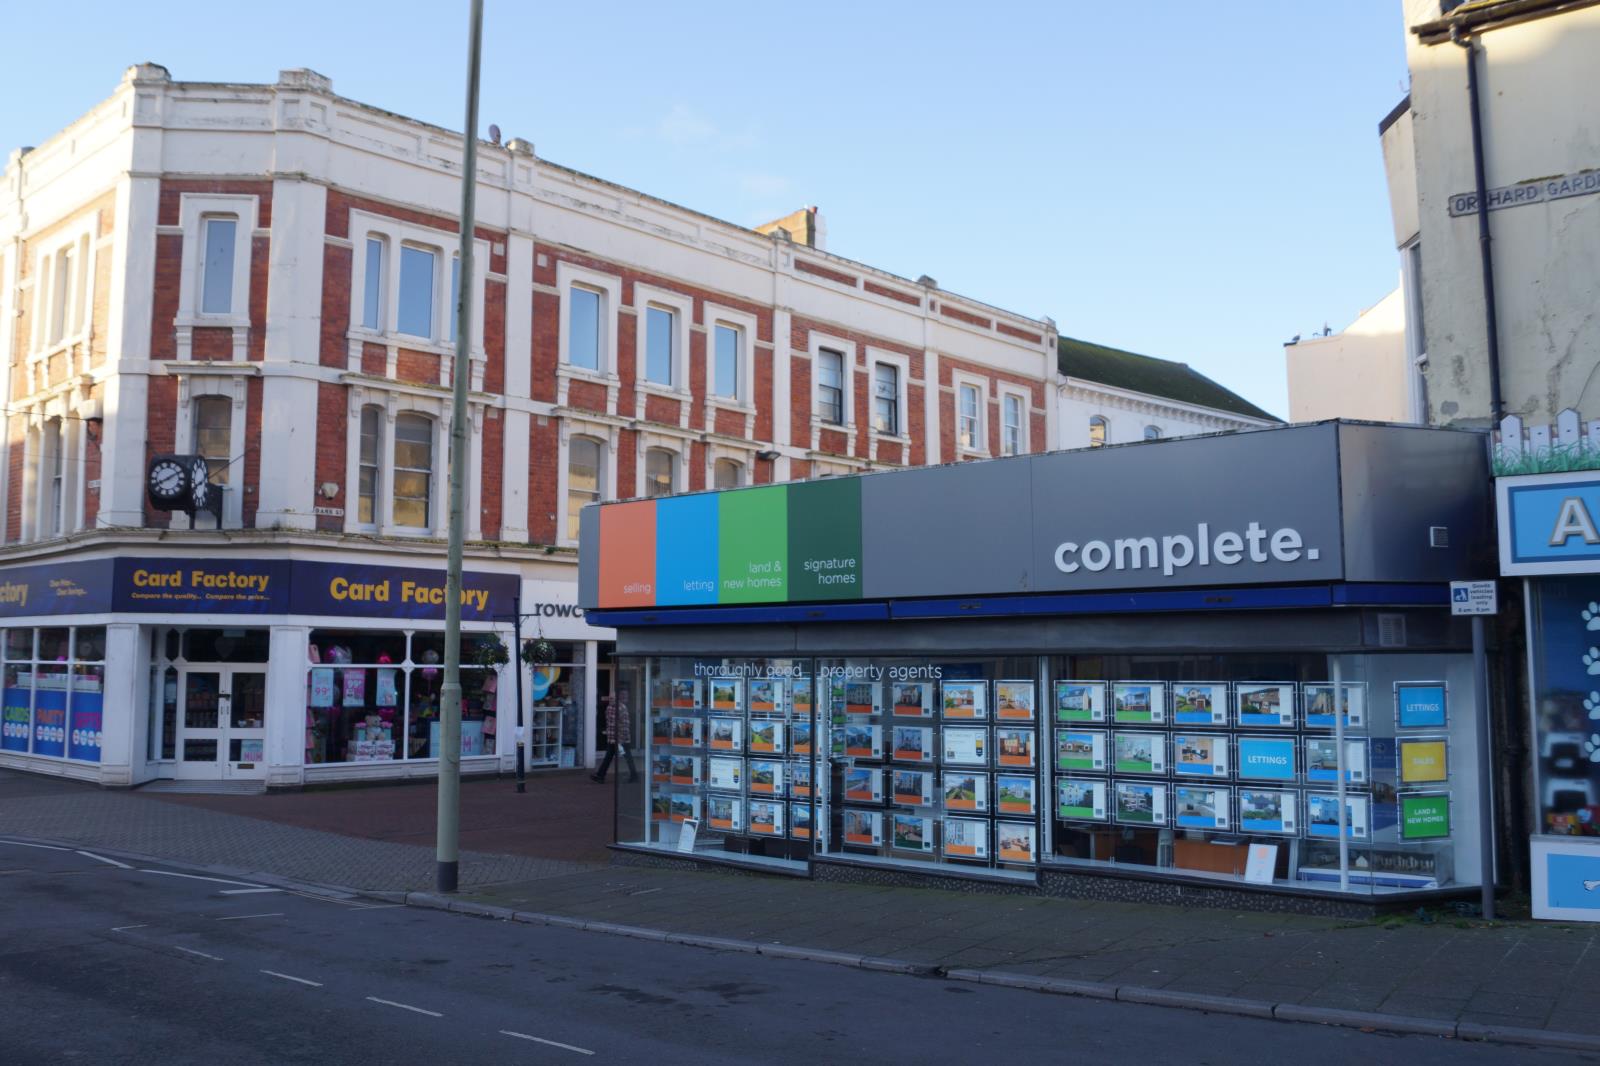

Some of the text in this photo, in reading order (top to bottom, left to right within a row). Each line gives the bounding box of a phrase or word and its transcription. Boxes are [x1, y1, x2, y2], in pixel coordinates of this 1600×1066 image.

[1455, 186, 1538, 212] ORHARD
[1054, 521, 1320, 576] complete.
[749, 561, 782, 574] land &
[803, 558, 856, 573] signature
[133, 569, 270, 592] Card Factory
[723, 576, 782, 590] new homes
[818, 573, 856, 585] homes
[330, 577, 390, 602] Card
[623, 583, 652, 595] selling
[683, 580, 714, 592] letting
[694, 662, 942, 681] thoroughly good property agents
[1406, 703, 1439, 712] LETTINGS
[1247, 755, 1287, 765] LETTINGS
[1414, 808, 1430, 816] LAND
